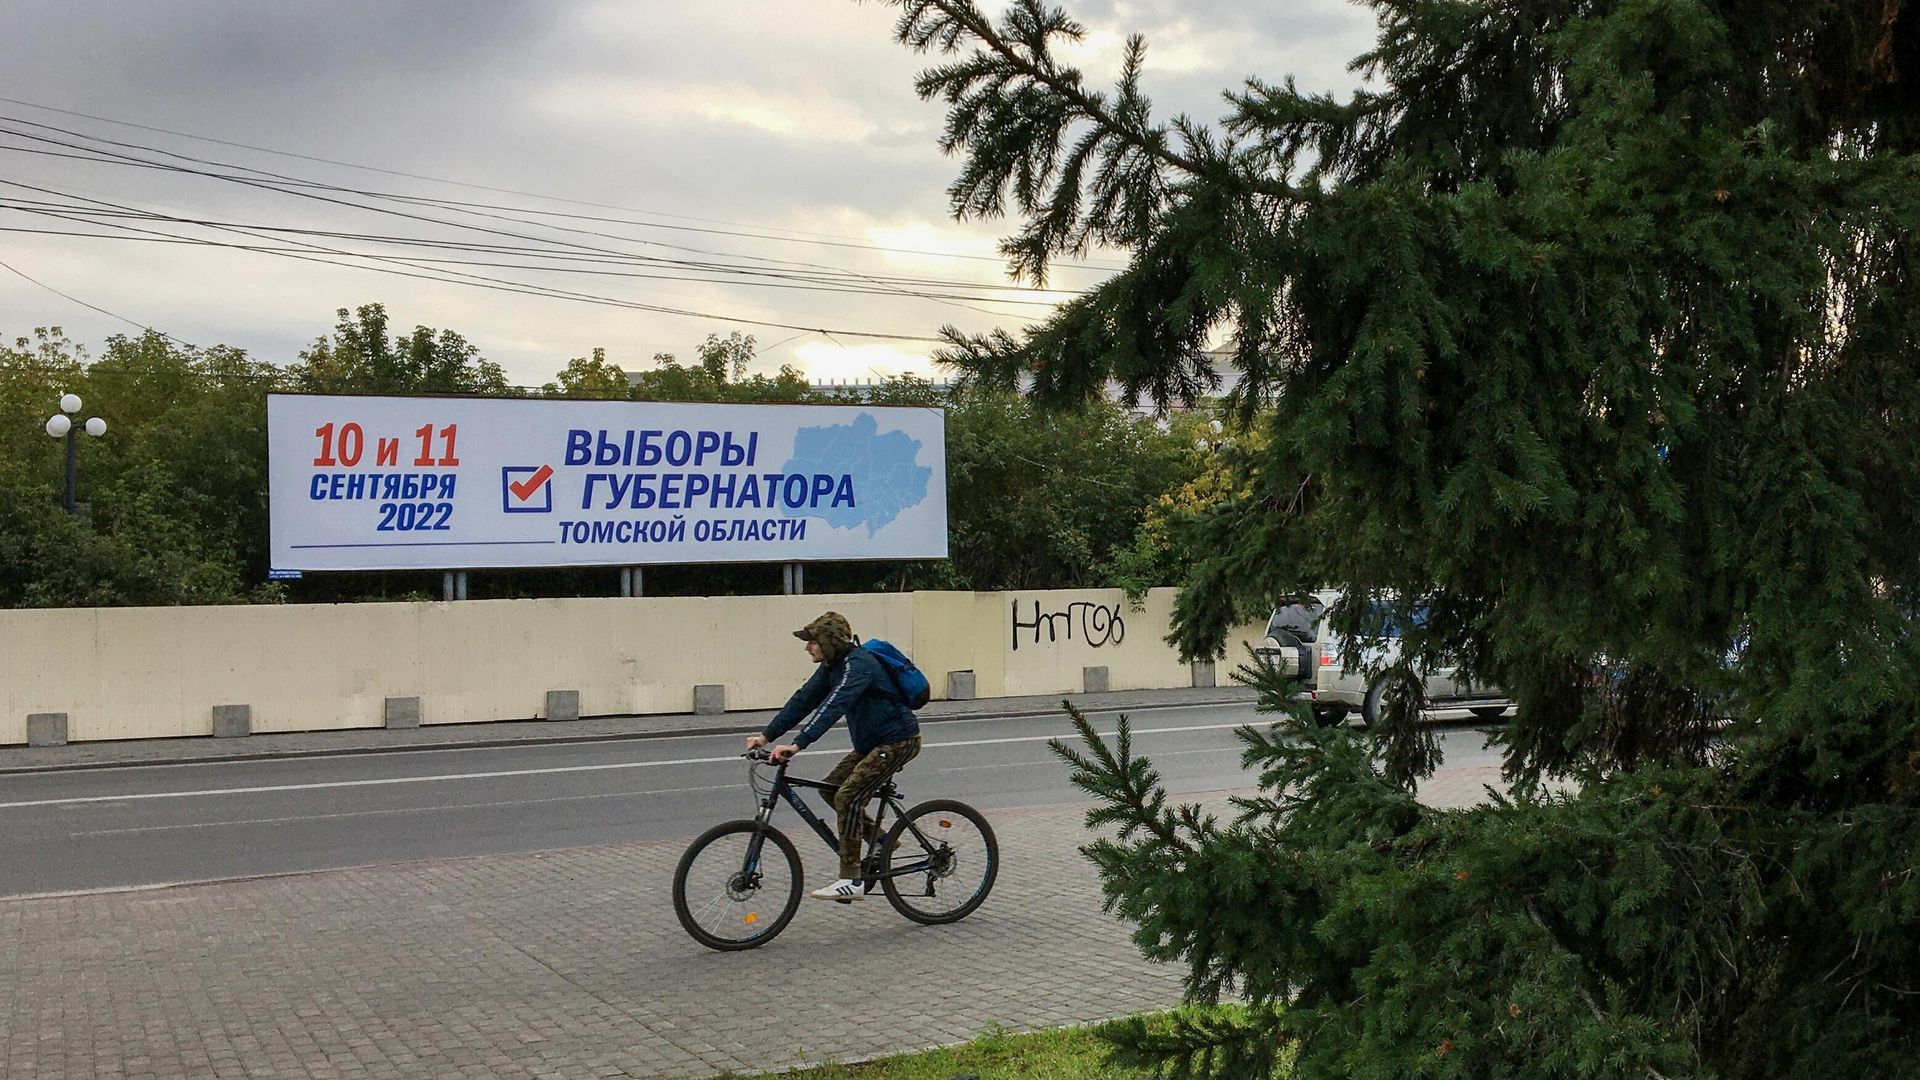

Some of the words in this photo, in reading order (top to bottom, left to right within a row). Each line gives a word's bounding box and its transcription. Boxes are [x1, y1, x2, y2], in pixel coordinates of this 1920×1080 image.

[313, 422, 365, 467] 10
[376, 437, 400, 467] и
[413, 424, 461, 467] 11
[564, 429, 758, 467] ВЫБОРЫ
[309, 473, 457, 501] СЕНТЯБРЯ
[581, 473, 856, 510] ГУБЕРНАТОРА
[376, 503, 454, 532] 2022
[559, 515, 686, 544] ТОМСКОЙ
[693, 518, 807, 542] ОБЛАСТИ
